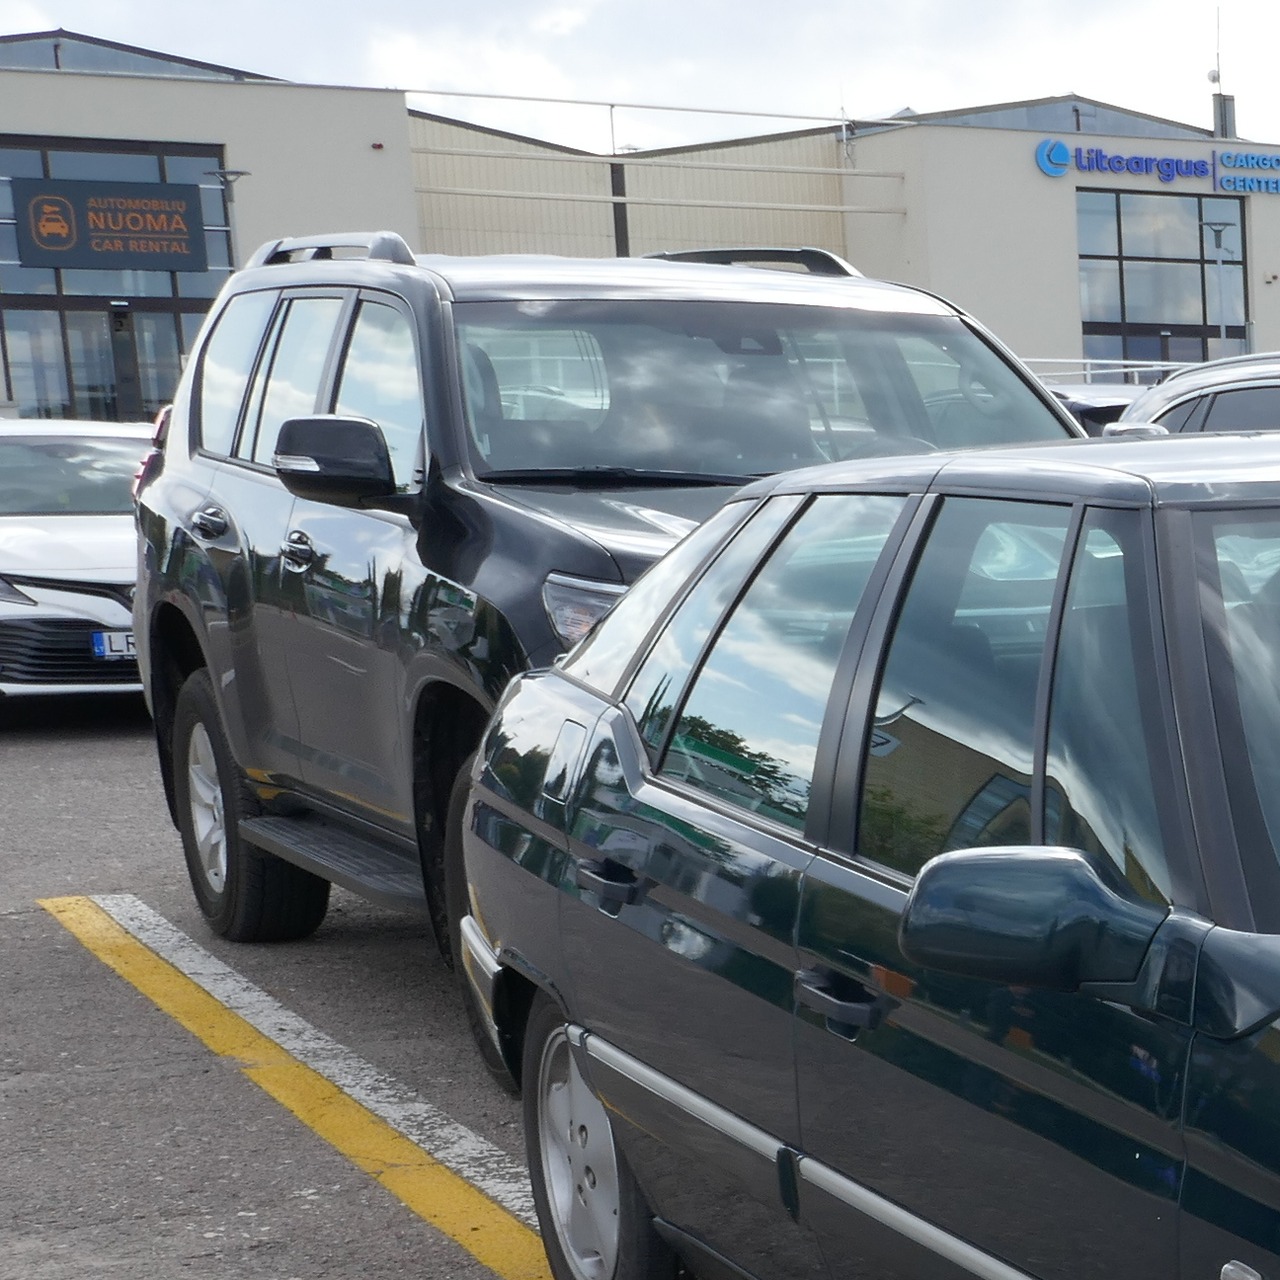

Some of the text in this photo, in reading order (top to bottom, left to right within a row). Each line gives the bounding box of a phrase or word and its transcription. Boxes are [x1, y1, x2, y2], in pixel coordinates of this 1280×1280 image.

[87, 211, 188, 232] NUOMA
[91, 239, 191, 254] CAR RENTAL
